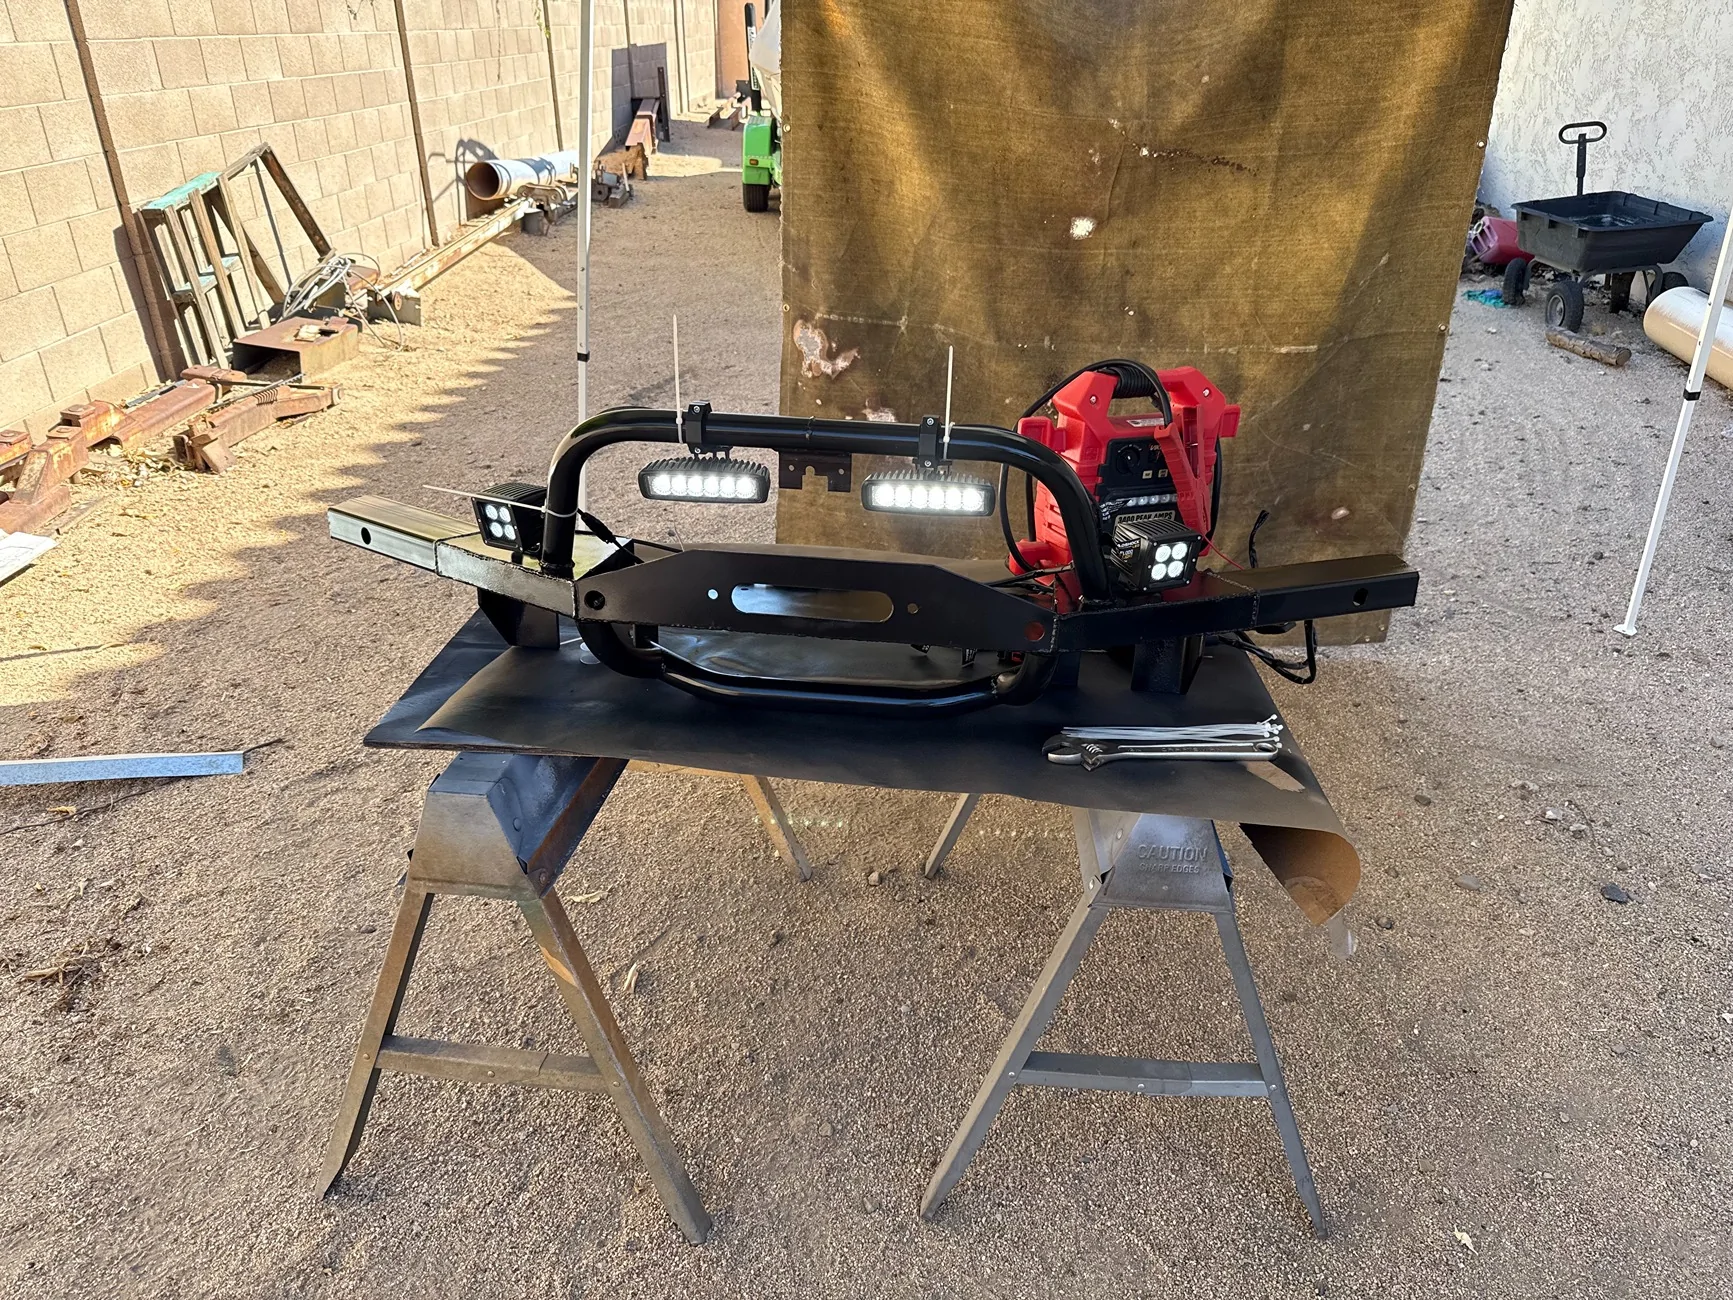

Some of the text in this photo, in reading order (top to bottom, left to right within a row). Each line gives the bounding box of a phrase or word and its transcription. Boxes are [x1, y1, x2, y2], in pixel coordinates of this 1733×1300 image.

[1136, 513, 1153, 522] PEAK
[1154, 511, 1173, 520] AMPS
[1138, 844, 1208, 862] CAUTION
[1139, 862, 1200, 874] SHARP EDGES
